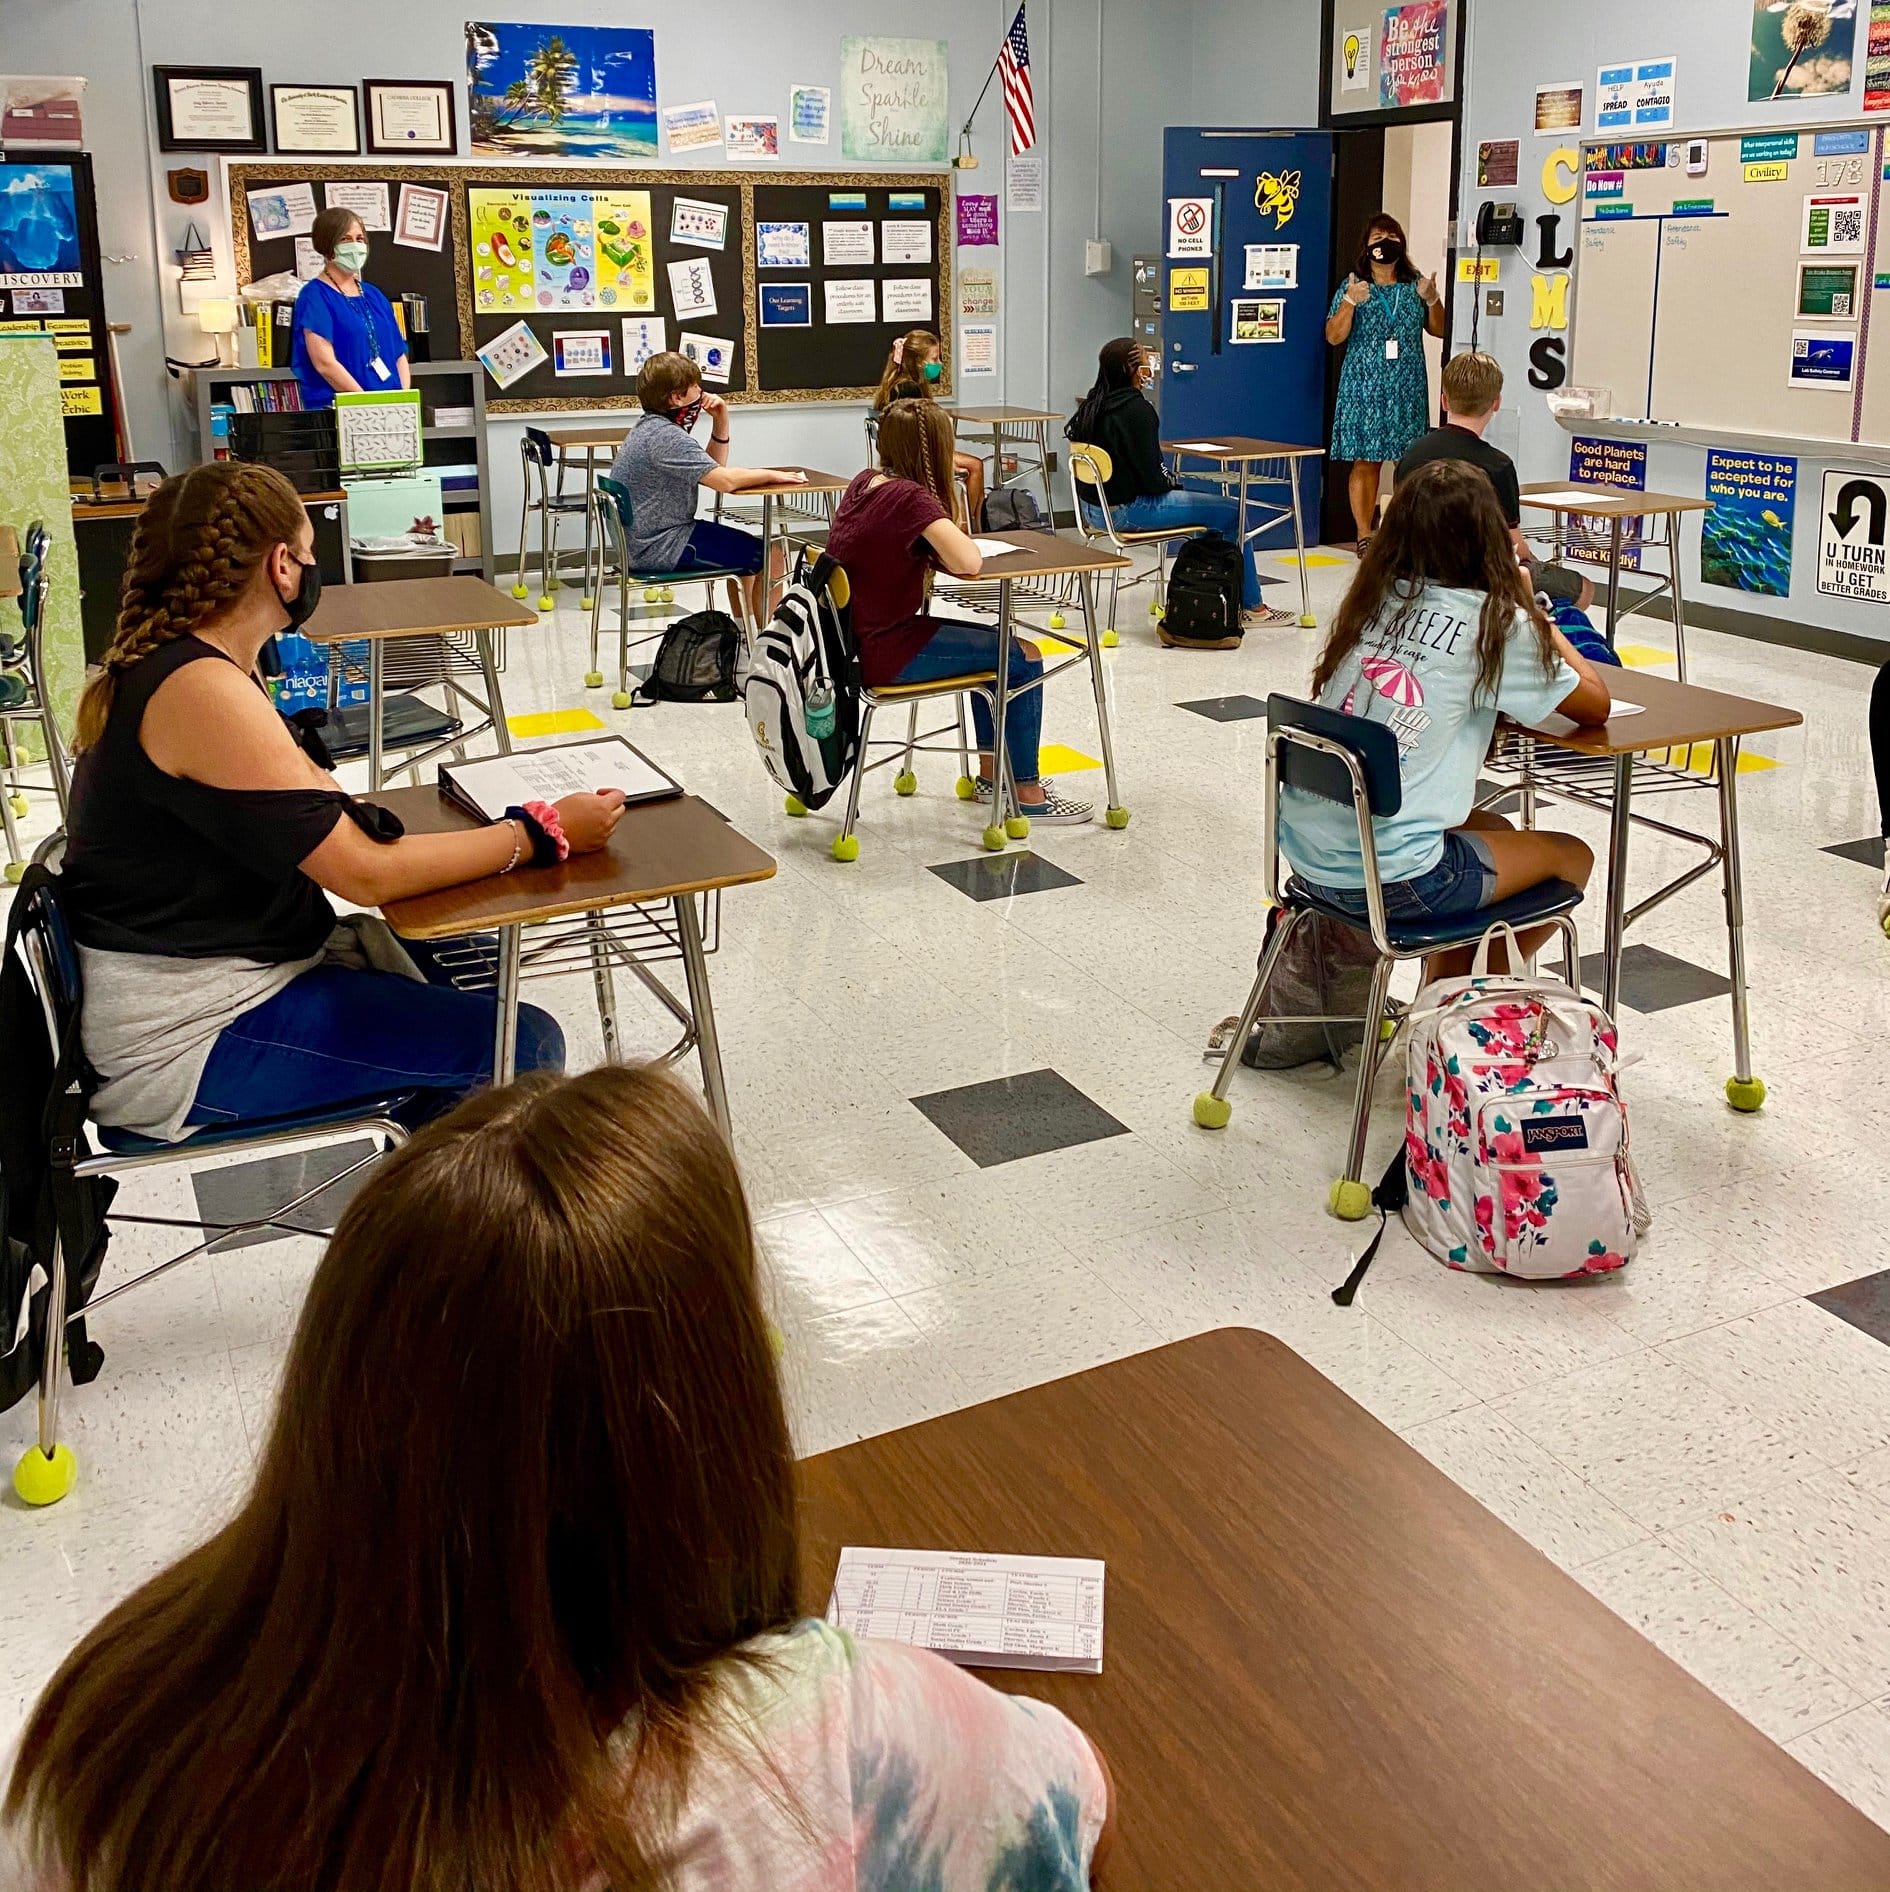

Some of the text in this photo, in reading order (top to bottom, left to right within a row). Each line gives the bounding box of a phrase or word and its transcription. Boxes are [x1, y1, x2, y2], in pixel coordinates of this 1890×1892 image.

[1387, 8, 1440, 42] Be the
[1385, 34, 1440, 57] strongest
[861, 46, 927, 75] Dream
[1391, 55, 1433, 73] person
[1385, 68, 1438, 99] you know
[1644, 80, 1664, 89] Ayuda
[860, 81, 928, 119] Sparkle
[1603, 100, 1628, 111] SPREAD
[1636, 96, 1670, 107] CONTAGIO
[867, 116, 924, 146] Shine
[1754, 139, 1783, 148] interpersonal
[1783, 138, 1795, 146] skills
[1756, 150, 1772, 159] working
[1779, 148, 1796, 157] today?
[1750, 167, 1783, 179] Civility
[1816, 159, 1862, 187] 178
[1586, 179, 1622, 192] Do Now #
[512, 193, 609, 202] Visualizing Cells
[1586, 238, 1604, 252] Safety
[1666, 236, 1687, 250] Safety
[1466, 264, 1492, 276] EXIT
[4, 273, 79, 286] ISCOVERY
[963, 297, 993, 305] change
[61, 390, 90, 400] Work
[62, 404, 91, 415] Ethic
[1575, 442, 1645, 460] Good Planets
[1584, 458, 1630, 471] are hard
[1712, 455, 1793, 473] Expect to be
[1579, 467, 1639, 485] to replace.
[1711, 471, 1794, 488] accepted for
[1710, 484, 1788, 502] who you are.
[1570, 547, 1637, 568] Treat Kidly!
[1827, 542, 1885, 565] U TURN
[1826, 558, 1885, 574] IN HOMEWORK
[1836, 571, 1874, 588] U GET
[1821, 581, 1887, 599] BETTER GRADES
[1384, 606, 1467, 656] BREEZE
[1400, 649, 1428, 662] ease
[1527, 1125, 1584, 1143] JANSPORT
